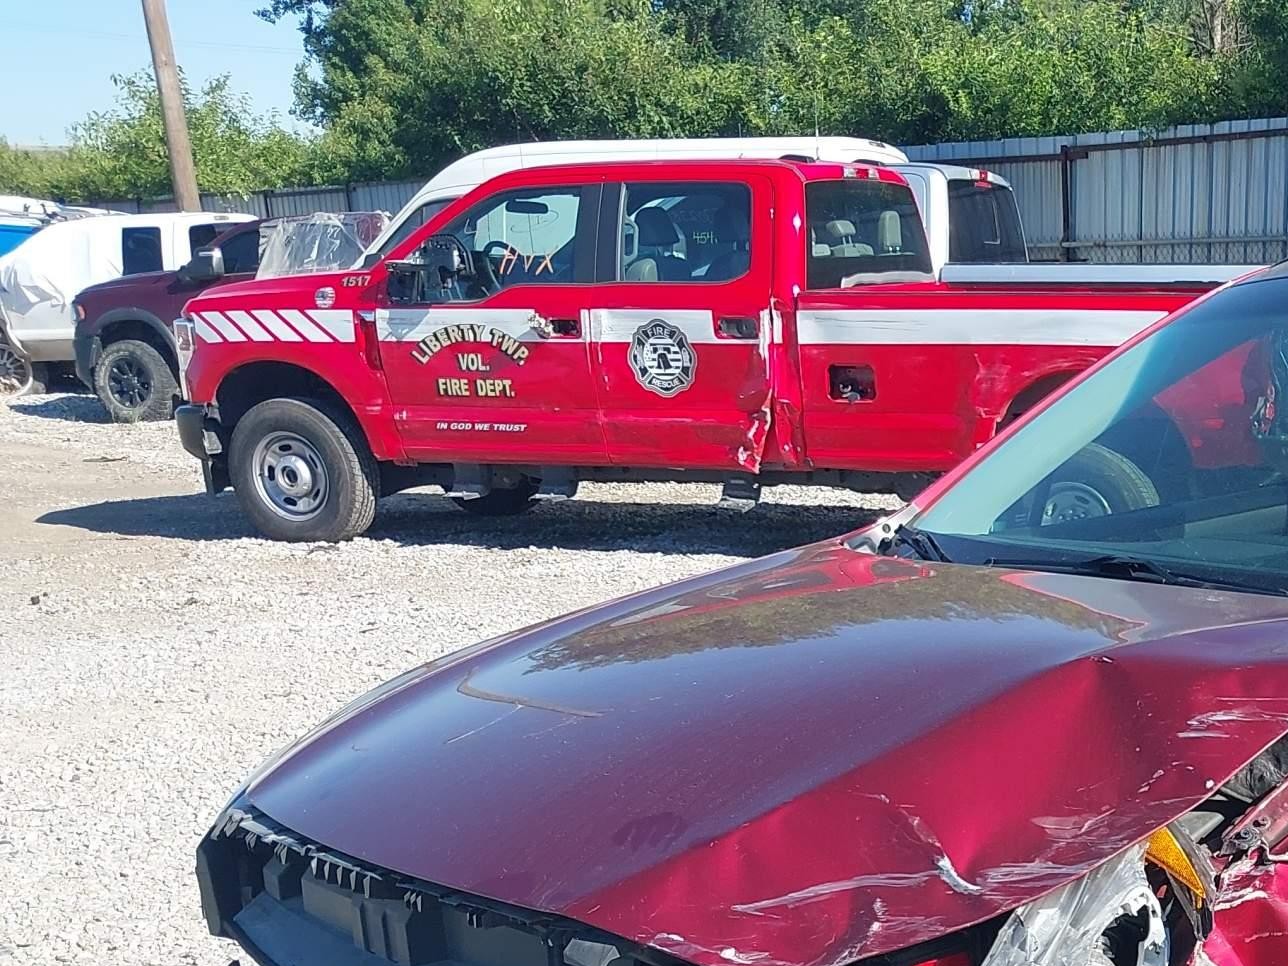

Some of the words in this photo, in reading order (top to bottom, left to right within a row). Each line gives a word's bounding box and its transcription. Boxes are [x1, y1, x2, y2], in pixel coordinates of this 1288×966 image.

[342, 275, 371, 287] 1517
[647, 326, 670, 337] FIRE
[410, 324, 486, 365] LIBERTY
[490, 328, 529, 366] TWP.
[457, 353, 490, 371] VOL.
[436, 378, 470, 397] FIRE
[474, 379, 515, 397] DEPT.
[651, 378, 681, 388] RESCUE
[436, 422, 448, 430] IN
[450, 422, 472, 430] GOD
[474, 423, 490, 431] WE
[493, 423, 527, 432] TRUST
